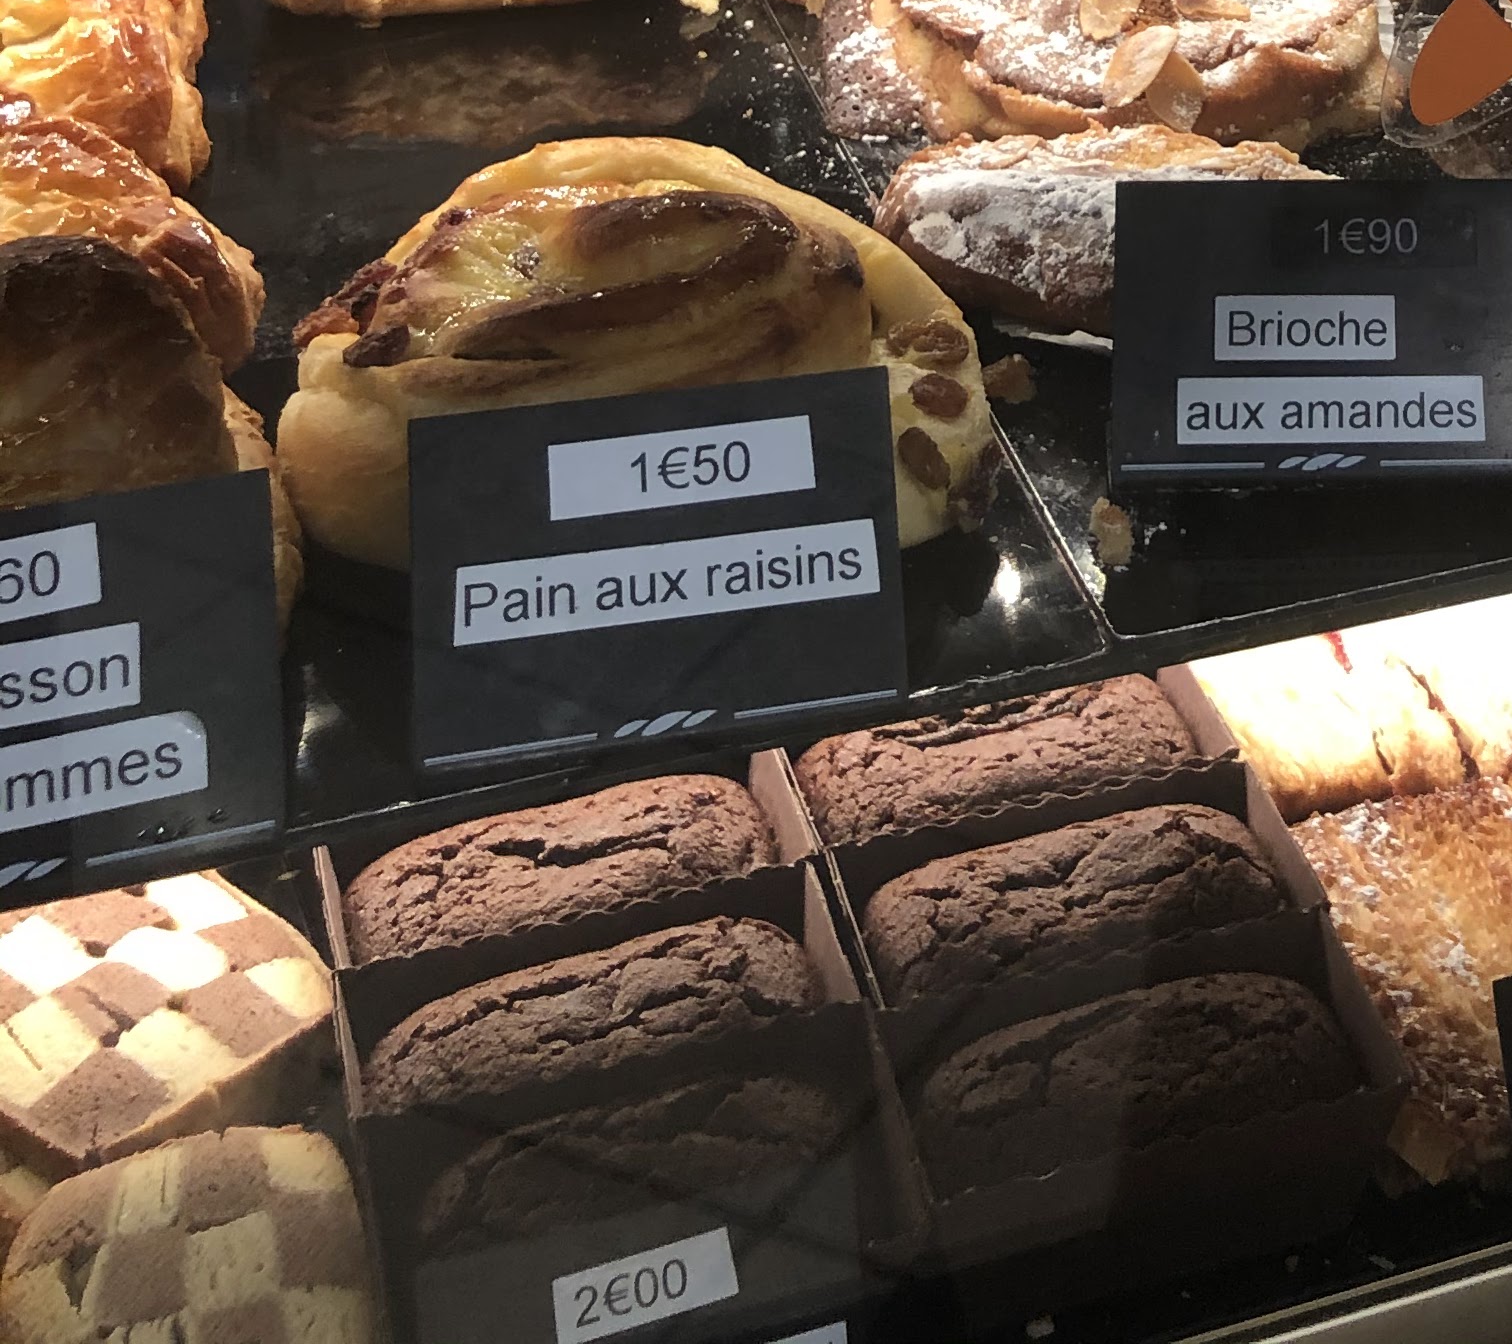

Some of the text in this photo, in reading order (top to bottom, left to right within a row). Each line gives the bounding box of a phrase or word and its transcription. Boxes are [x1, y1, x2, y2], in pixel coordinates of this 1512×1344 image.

[1313, 216, 1419, 255] 1€90
[1226, 309, 1388, 349] Brioche
[1185, 391, 1478, 431] aux amandes
[628, 441, 753, 494] 1€50
[463, 545, 864, 628] Pain aux raisins
[573, 1258, 689, 1328] 2€00
